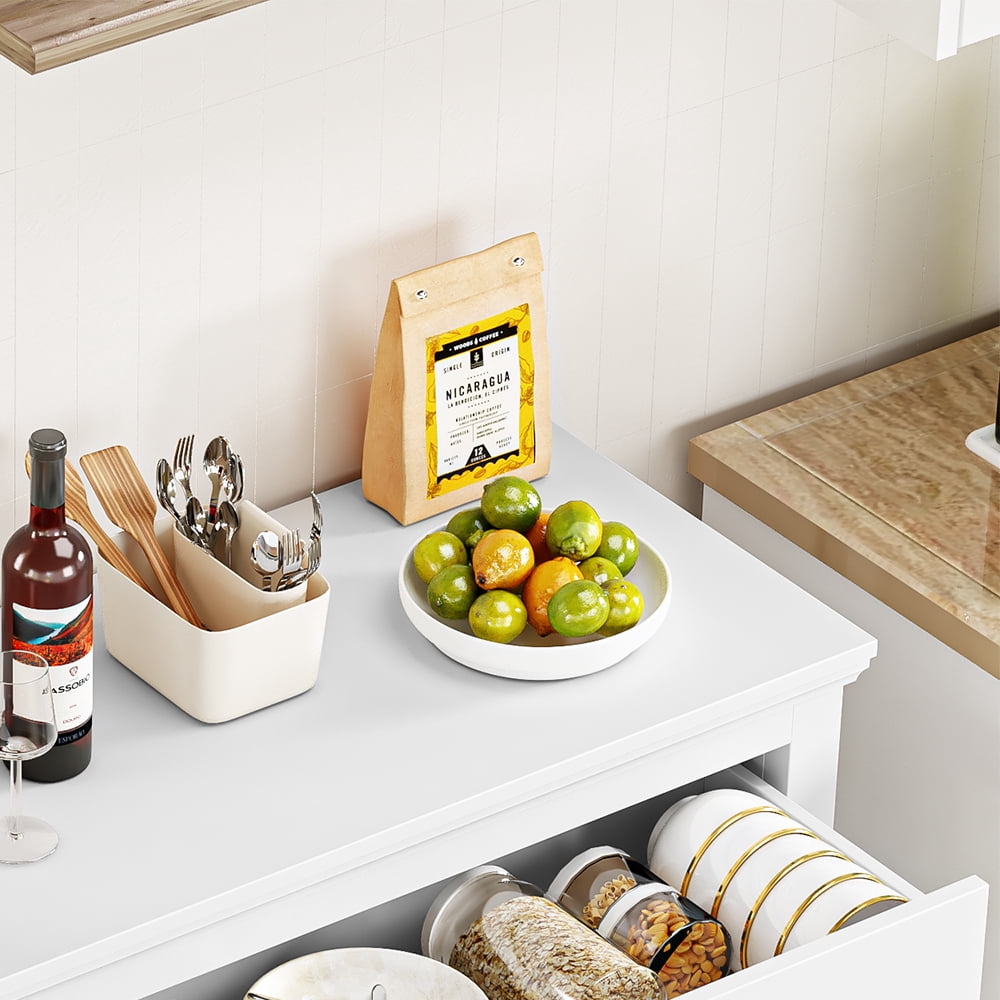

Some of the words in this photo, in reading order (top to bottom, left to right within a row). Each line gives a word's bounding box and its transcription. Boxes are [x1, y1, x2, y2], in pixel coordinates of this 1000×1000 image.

[453, 340, 474, 351] WOODS
[479, 331, 500, 343] COFFEE
[443, 362, 463, 374] SINGLE
[491, 347, 511, 358] ORIGIN
[446, 371, 511, 401] NICARAGUA
[474, 446, 484, 457] 12
